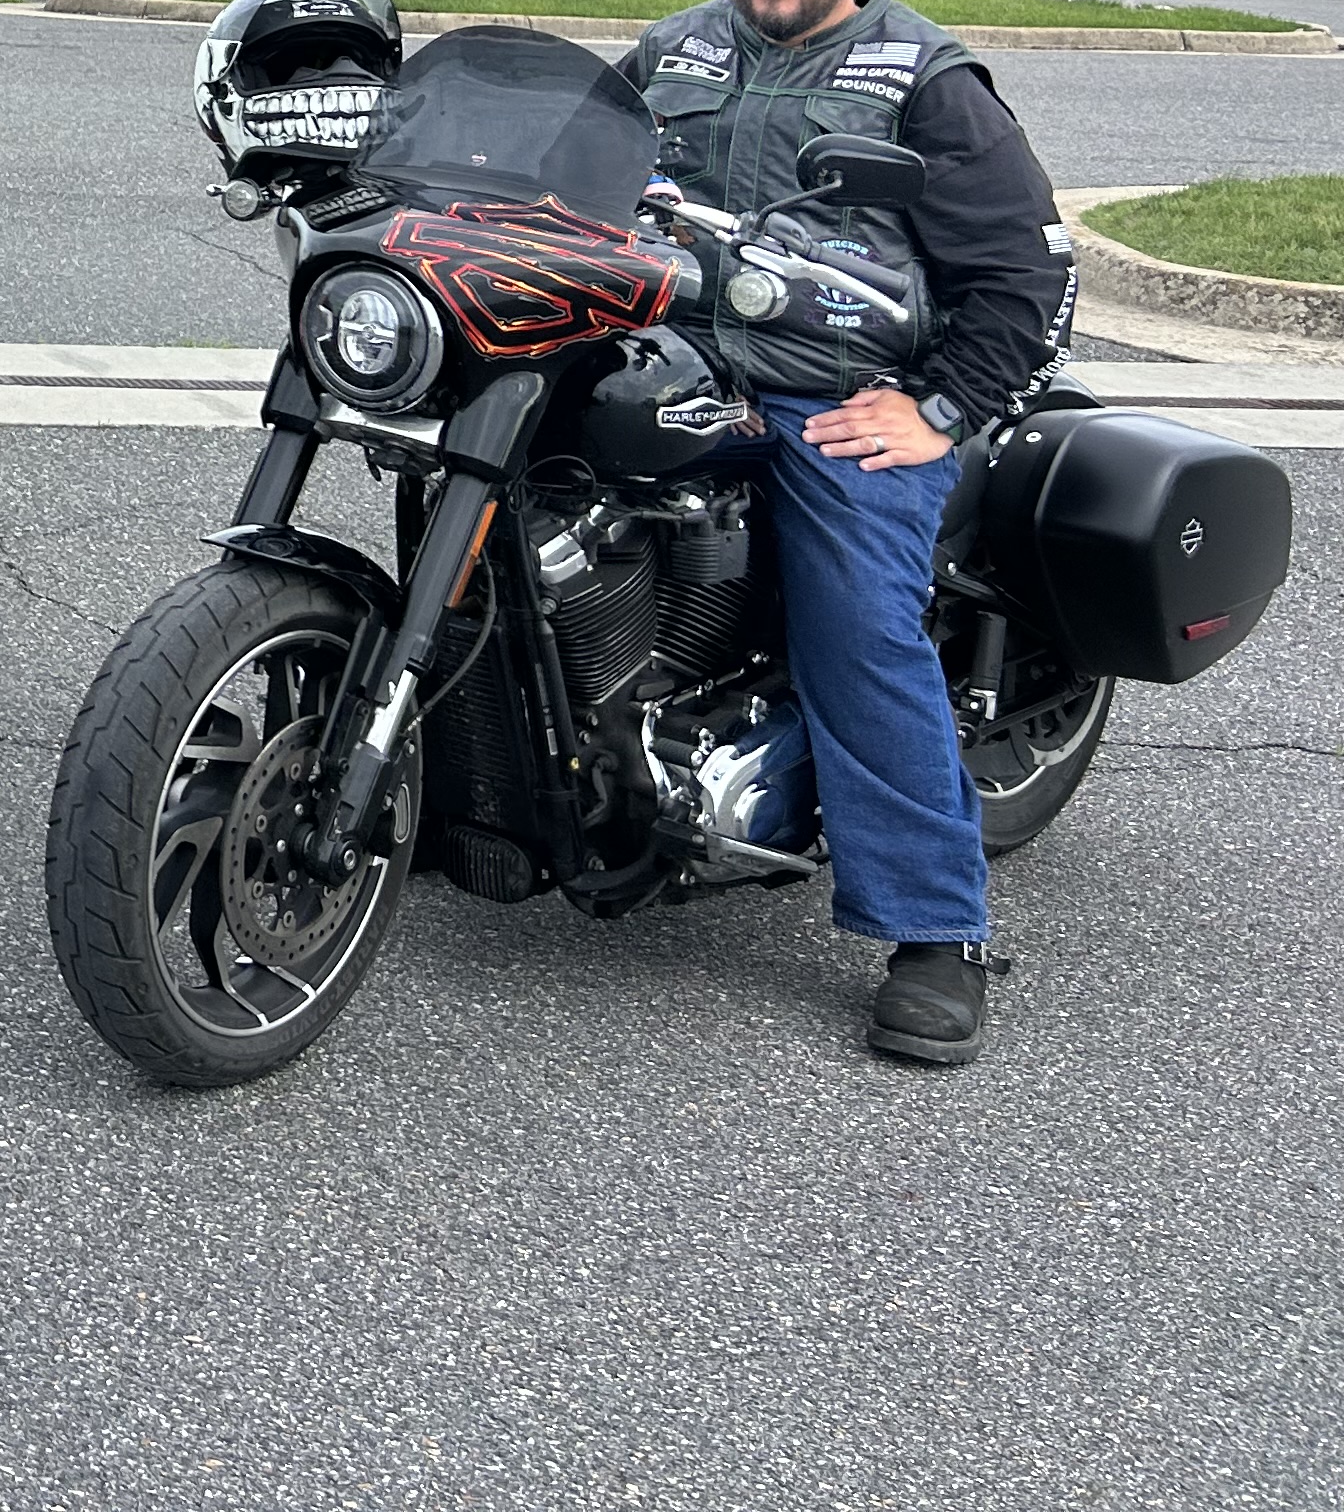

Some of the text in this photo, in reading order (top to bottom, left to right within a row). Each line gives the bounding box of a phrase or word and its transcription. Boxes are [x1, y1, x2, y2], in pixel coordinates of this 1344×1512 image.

[867, 67, 915, 86] CAPTAIN
[832, 78, 905, 104] FOUNDER
[1052, 265, 1077, 327] VALLEY
[825, 313, 862, 327] 2023
